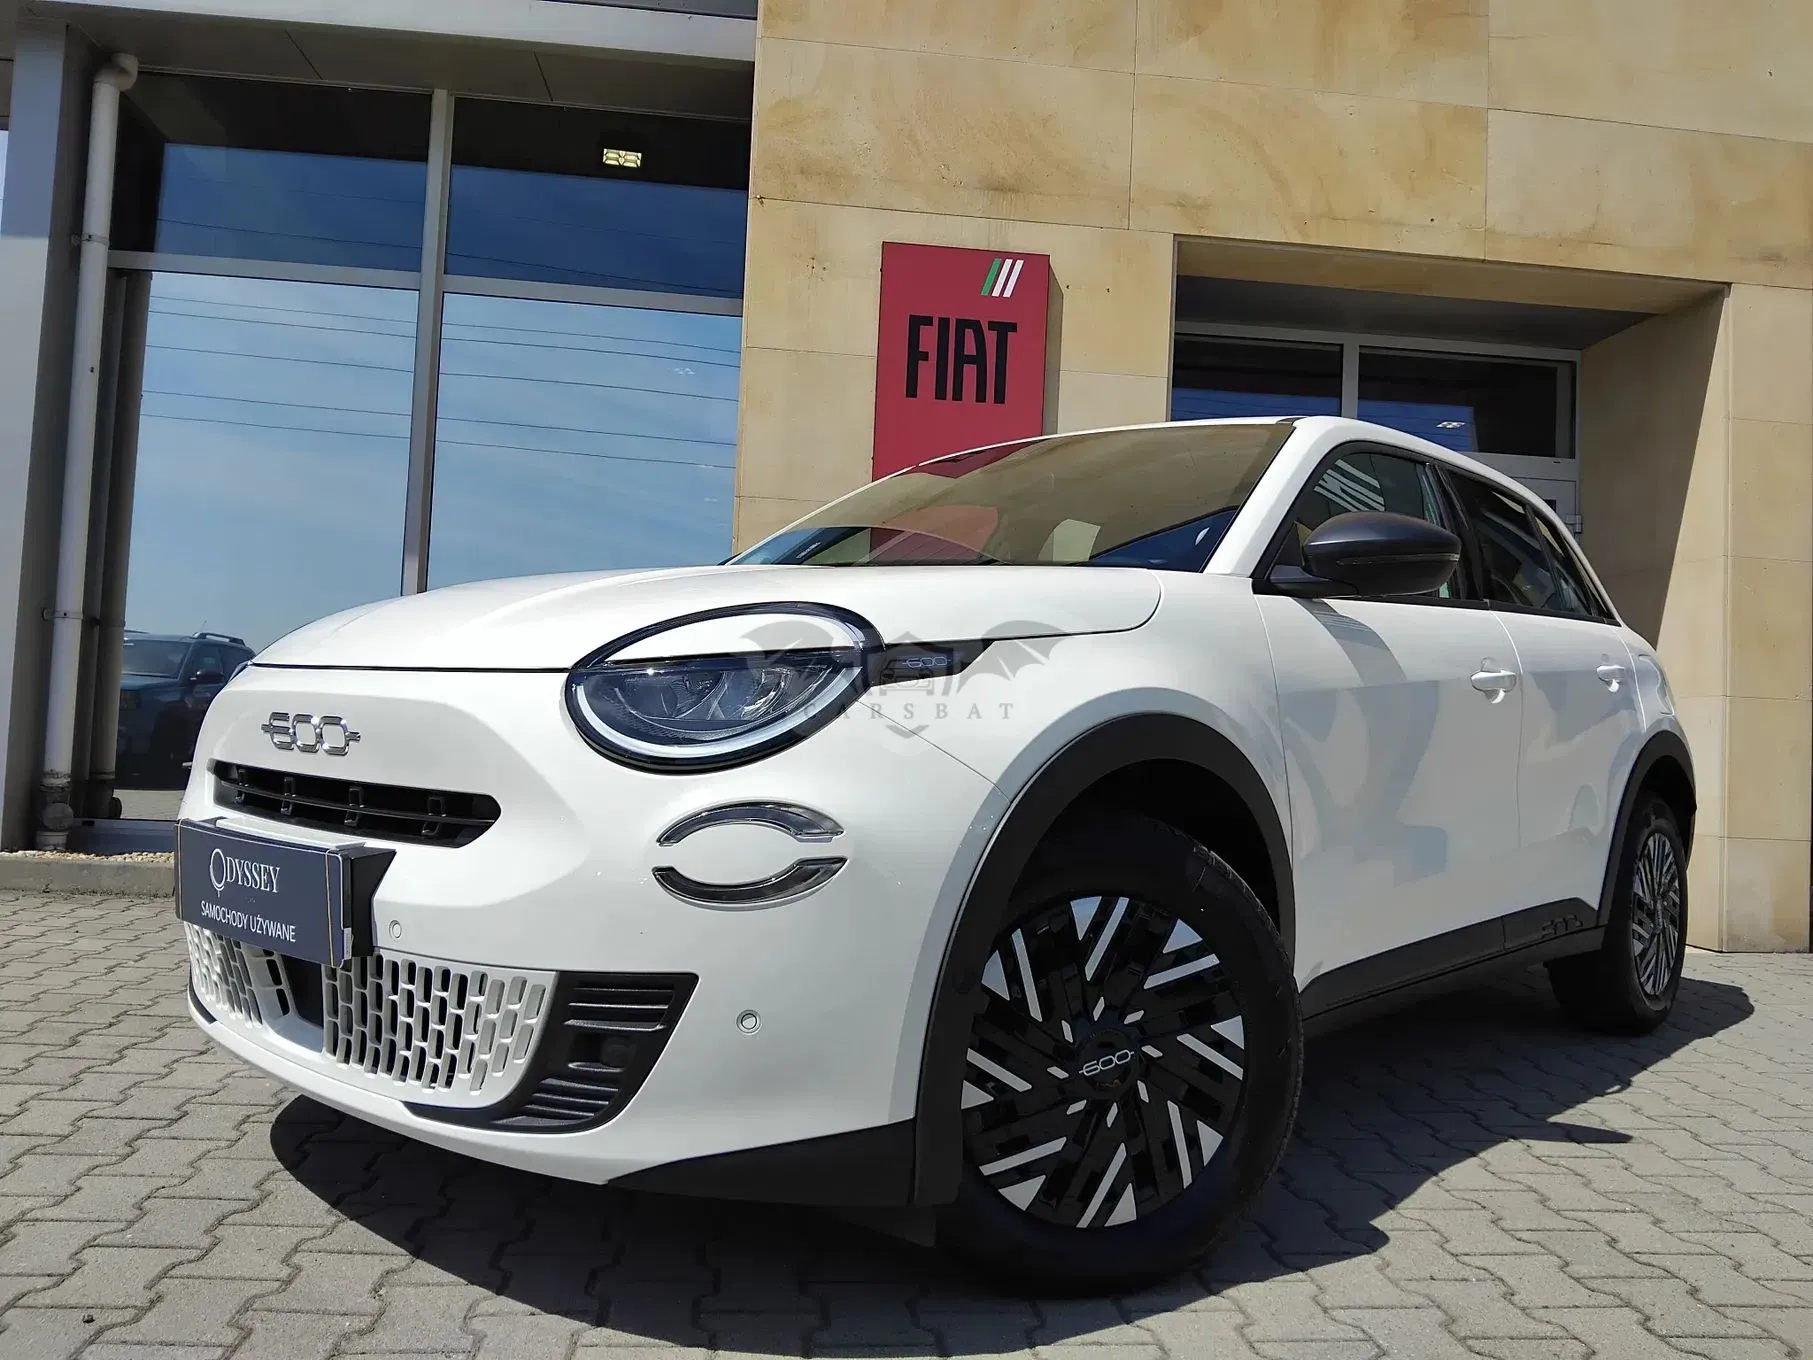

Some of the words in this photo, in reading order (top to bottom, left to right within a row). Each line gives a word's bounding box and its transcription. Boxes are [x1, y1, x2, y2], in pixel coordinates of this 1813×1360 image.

[905, 314, 1018, 404] FIAT
[905, 656, 950, 668] 600
[264, 711, 357, 756] 600
[201, 900, 248, 931] SAMOCHODY
[249, 914, 297, 943] UŻYWANE
[1081, 1049, 1133, 1076] 600
